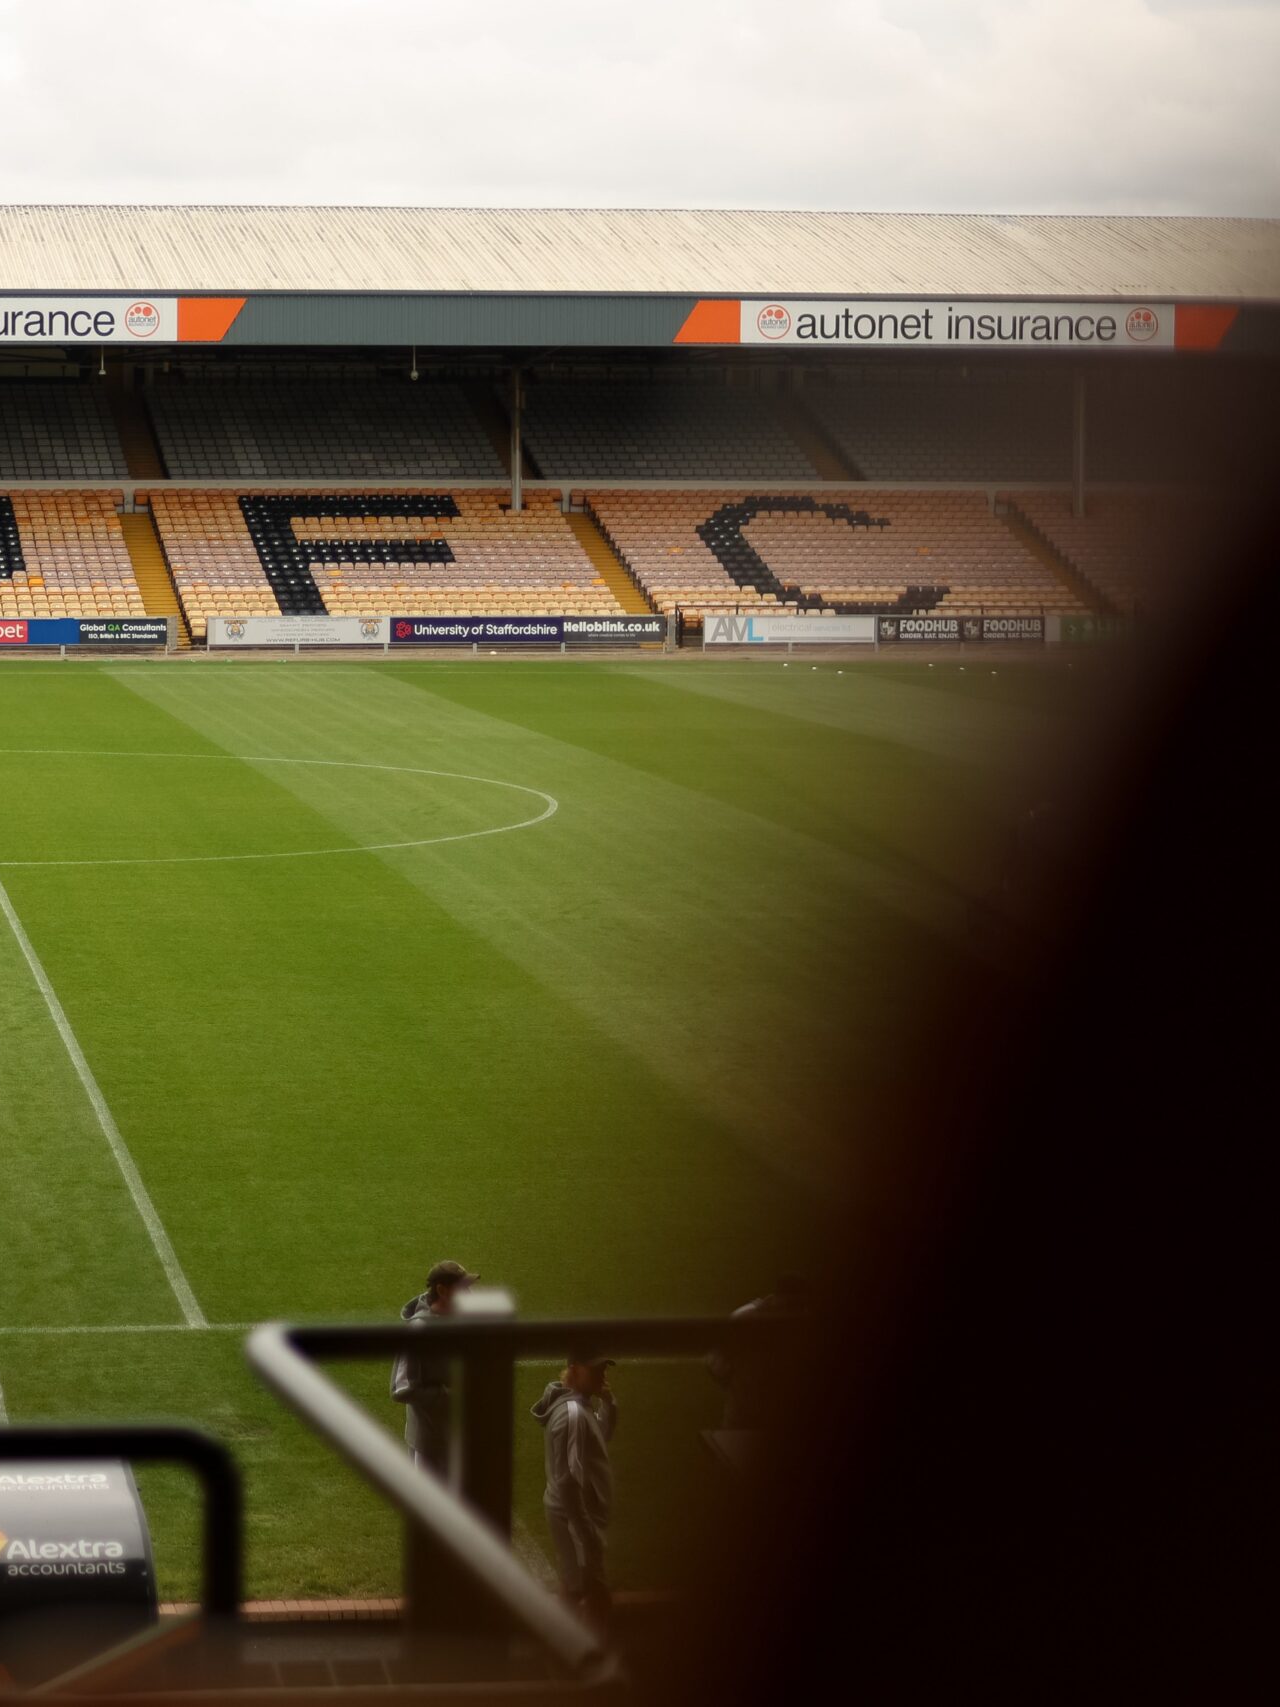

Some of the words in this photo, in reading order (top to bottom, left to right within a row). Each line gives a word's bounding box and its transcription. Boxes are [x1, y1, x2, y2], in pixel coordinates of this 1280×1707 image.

[128, 315, 156, 323] autonet
[761, 318, 787, 326] autonet
[796, 307, 933, 341] autonet
[947, 306, 1117, 341] insurance
[238, 495, 460, 616] F
[695, 495, 951, 616] C
[80, 623, 106, 632] Global
[107, 624, 120, 632] QA
[122, 623, 167, 632] Consultants
[414, 624, 470, 638] University
[471, 624, 483, 635] of
[486, 624, 557, 636] Staffordshire
[563, 621, 660, 632] Helloblink.co.uk
[710, 617, 764, 642] AML
[899, 619, 958, 633] FOODHUB
[983, 619, 1042, 633] FOODHUB
[6, 1538, 124, 1560] Alextra
[7, 1561, 126, 1577] accountants
